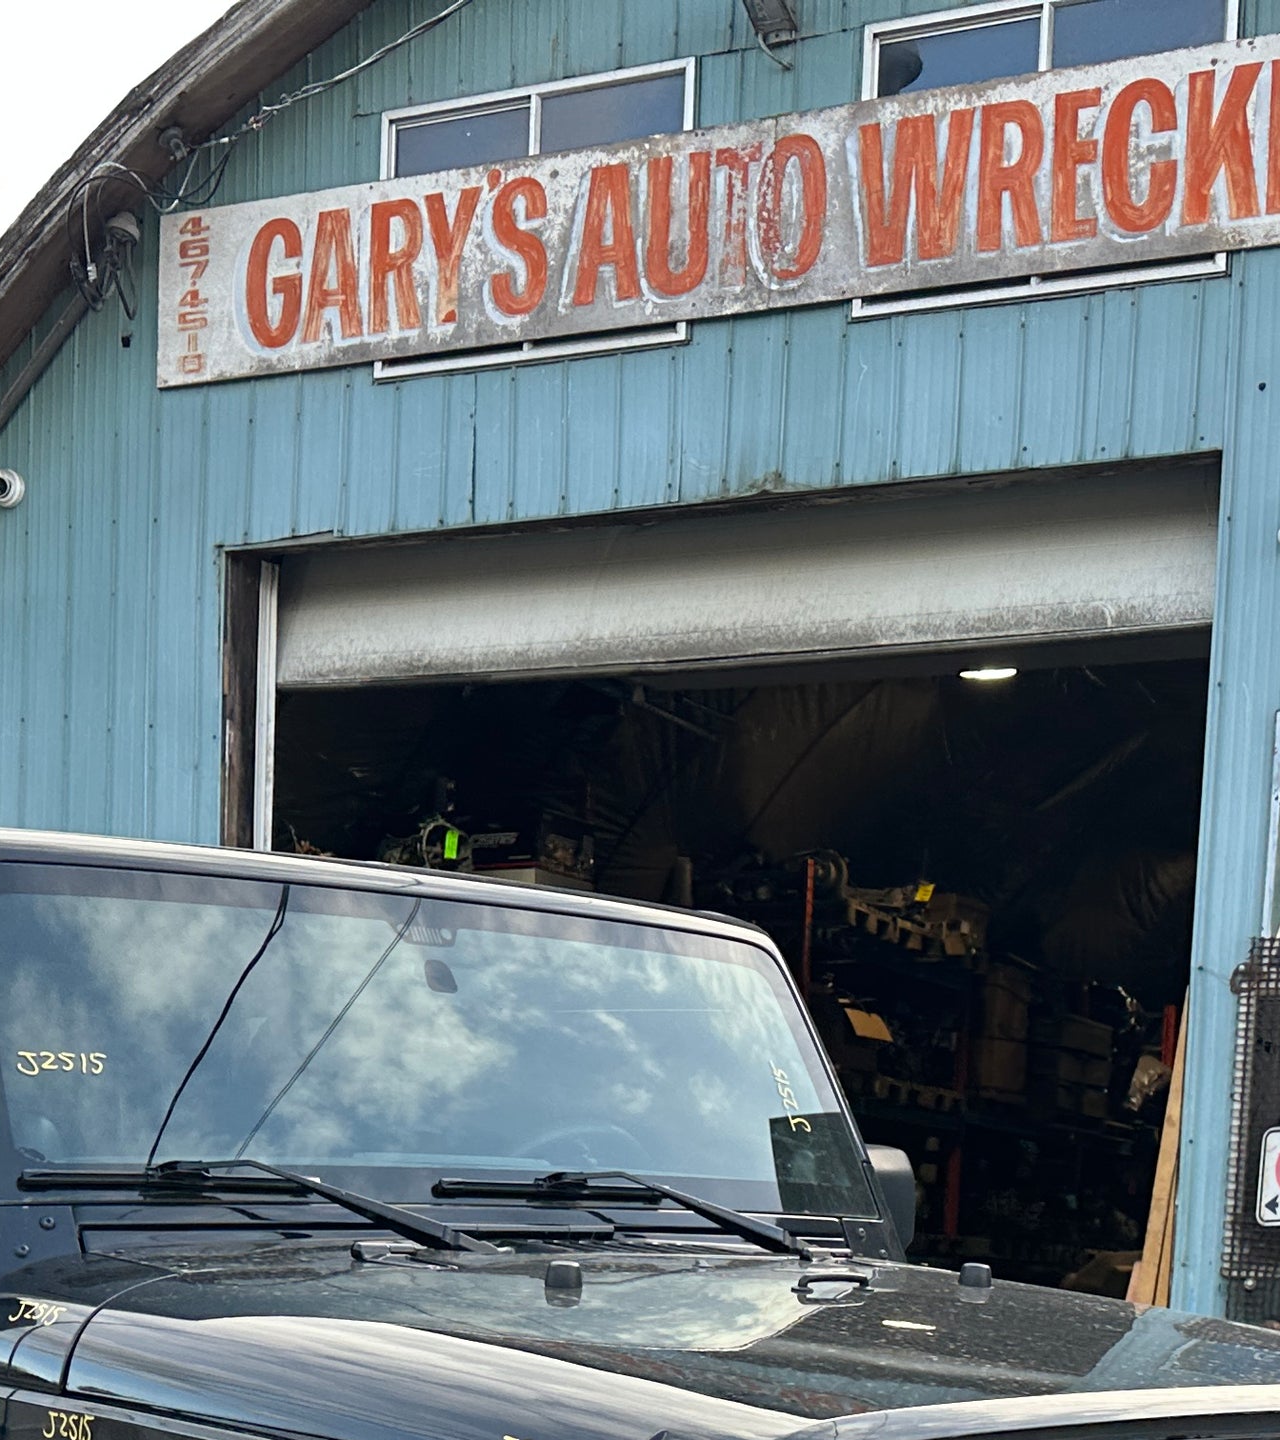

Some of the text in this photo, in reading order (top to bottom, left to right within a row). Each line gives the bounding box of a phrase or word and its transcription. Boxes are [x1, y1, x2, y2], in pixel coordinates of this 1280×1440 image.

[242, 168, 549, 350] GARY'S
[571, 133, 828, 308] AUTO
[16, 1050, 108, 1076] J2515
[768, 1059, 812, 1133] J2515
[7, 1299, 69, 1327] J2515
